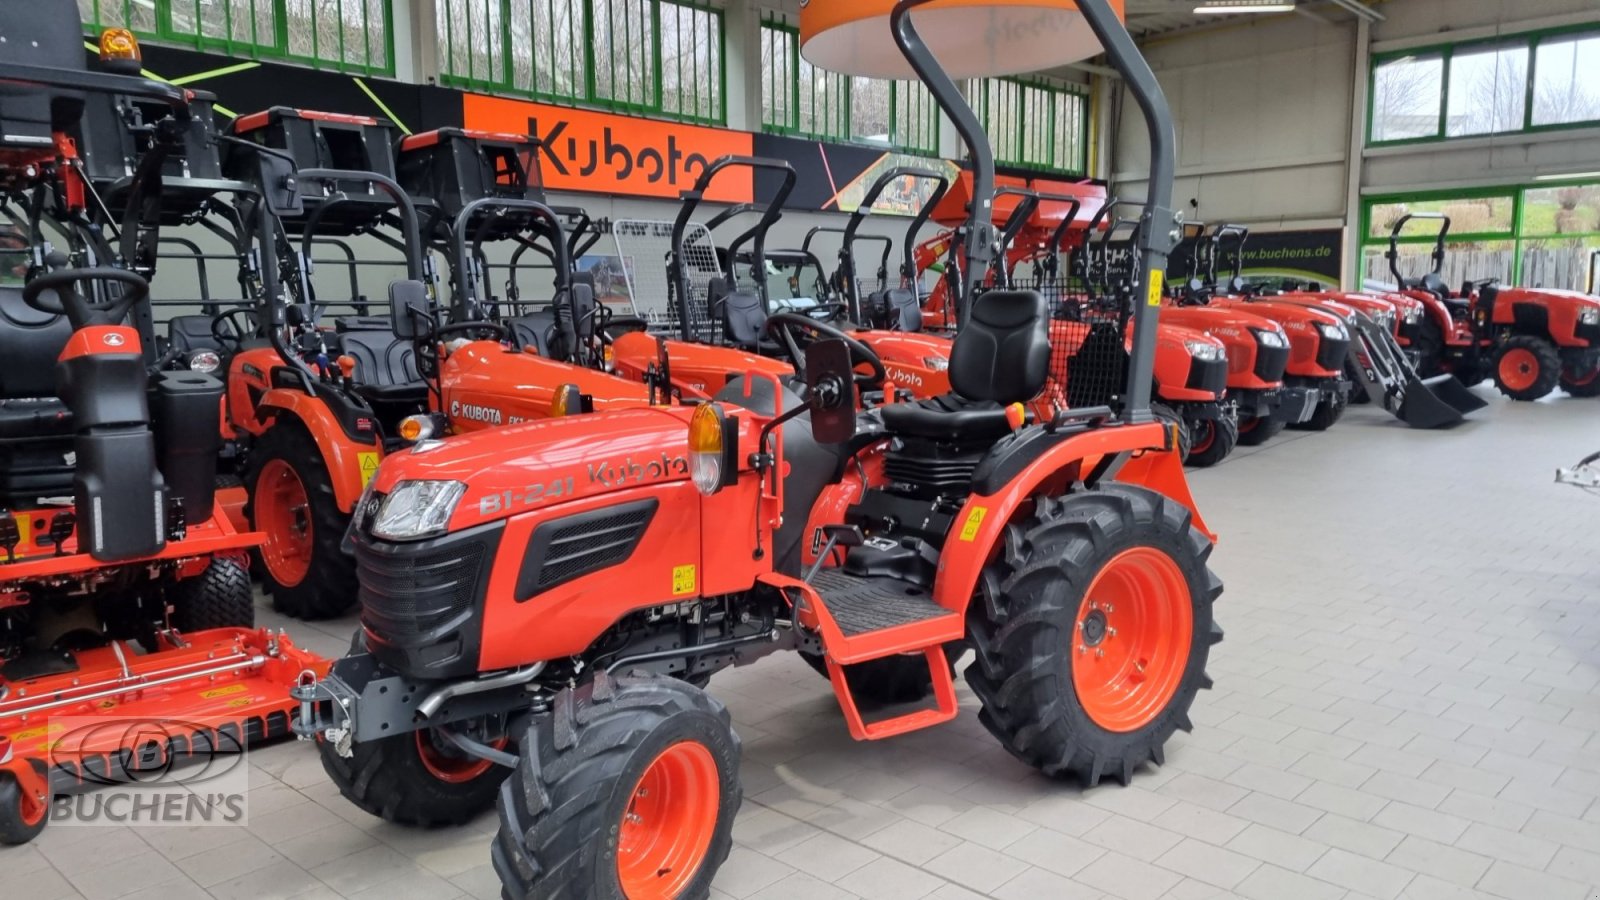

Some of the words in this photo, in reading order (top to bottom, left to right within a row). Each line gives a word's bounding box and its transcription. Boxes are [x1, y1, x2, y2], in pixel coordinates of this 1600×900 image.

[462, 404, 501, 424] KUBOTA
[587, 452, 689, 487] Kubota
[479, 476, 575, 516] B1-241
